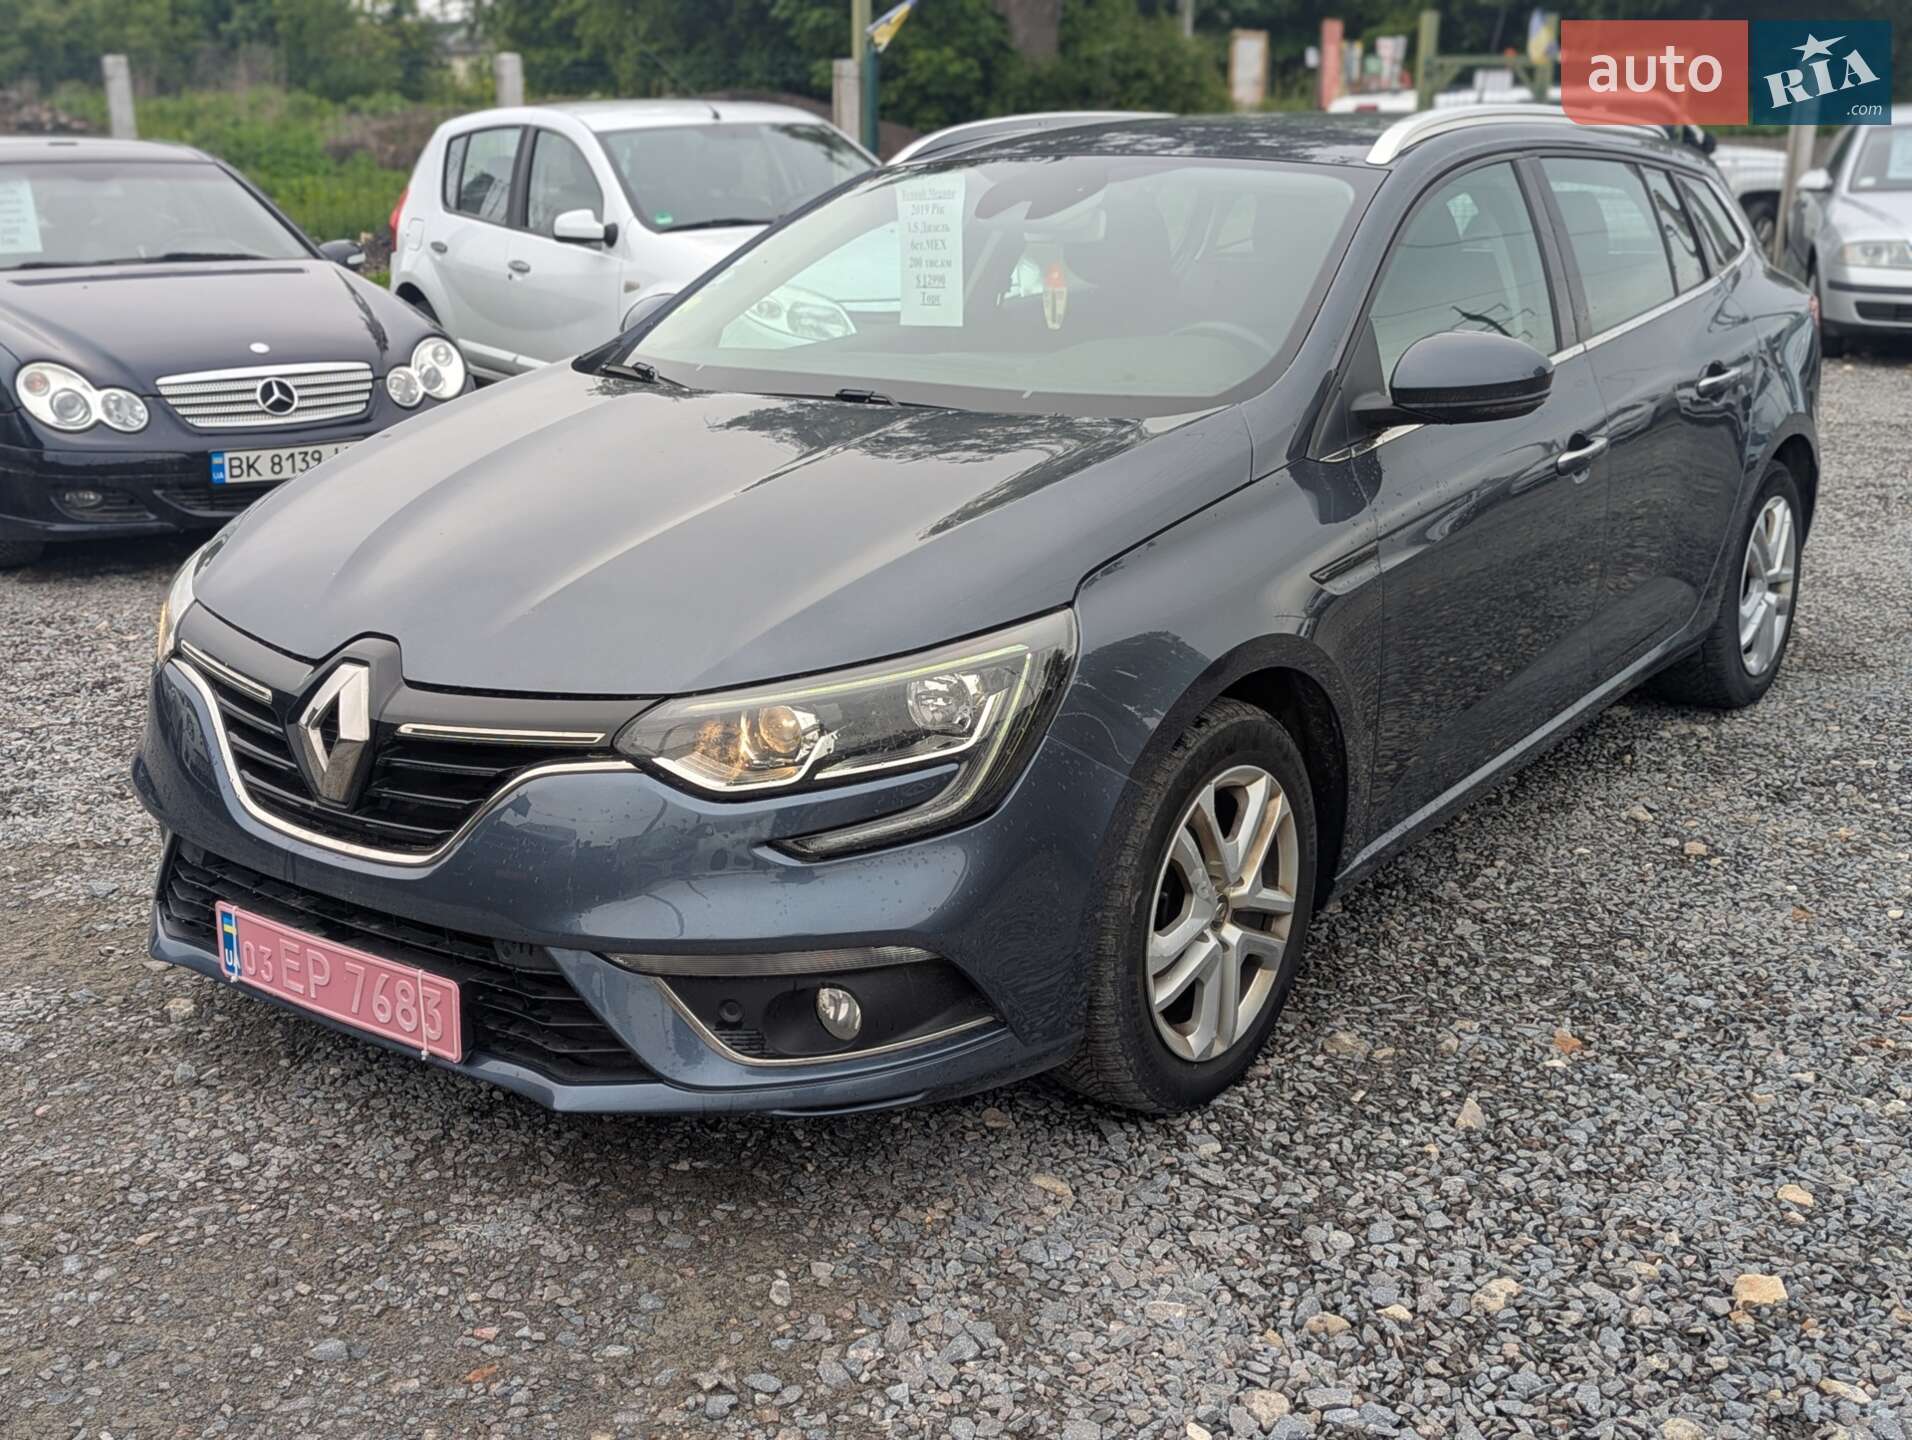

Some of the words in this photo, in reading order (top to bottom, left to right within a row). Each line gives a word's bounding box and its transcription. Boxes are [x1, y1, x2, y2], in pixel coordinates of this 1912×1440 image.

[228, 454, 263, 479] BK
[243, 940, 273, 983] 03
[279, 938, 331, 999] EP
[345, 960, 443, 1041] 7683
